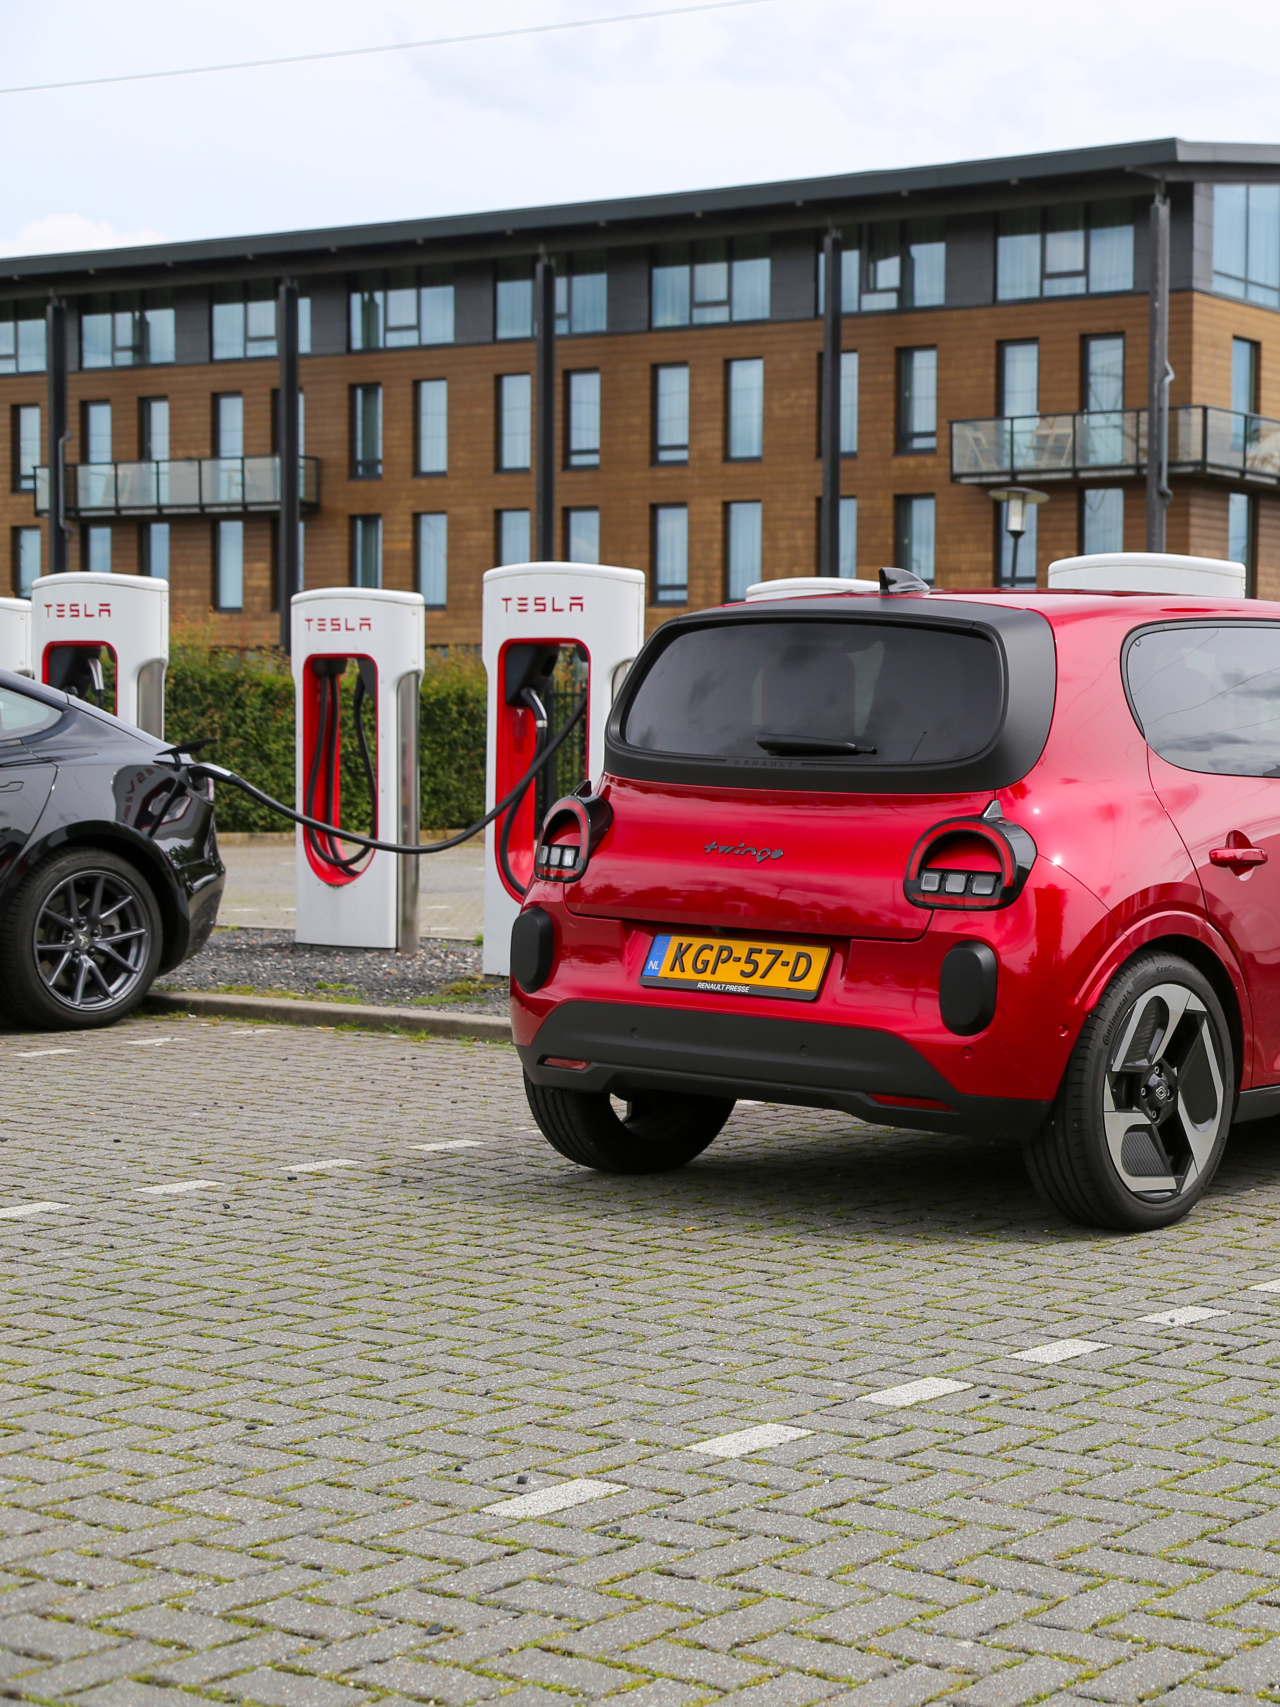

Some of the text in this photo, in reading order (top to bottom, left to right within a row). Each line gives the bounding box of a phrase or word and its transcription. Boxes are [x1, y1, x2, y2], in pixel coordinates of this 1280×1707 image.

[44, 603, 111, 618] TESLA
[500, 596, 584, 613] TESLA
[304, 617, 372, 632] TESLA
[734, 759, 794, 768] RENAULT
[647, 960, 660, 971] NL
[669, 942, 813, 982] KGP-57-D
[696, 981, 751, 993] RENAULT PRESSE
